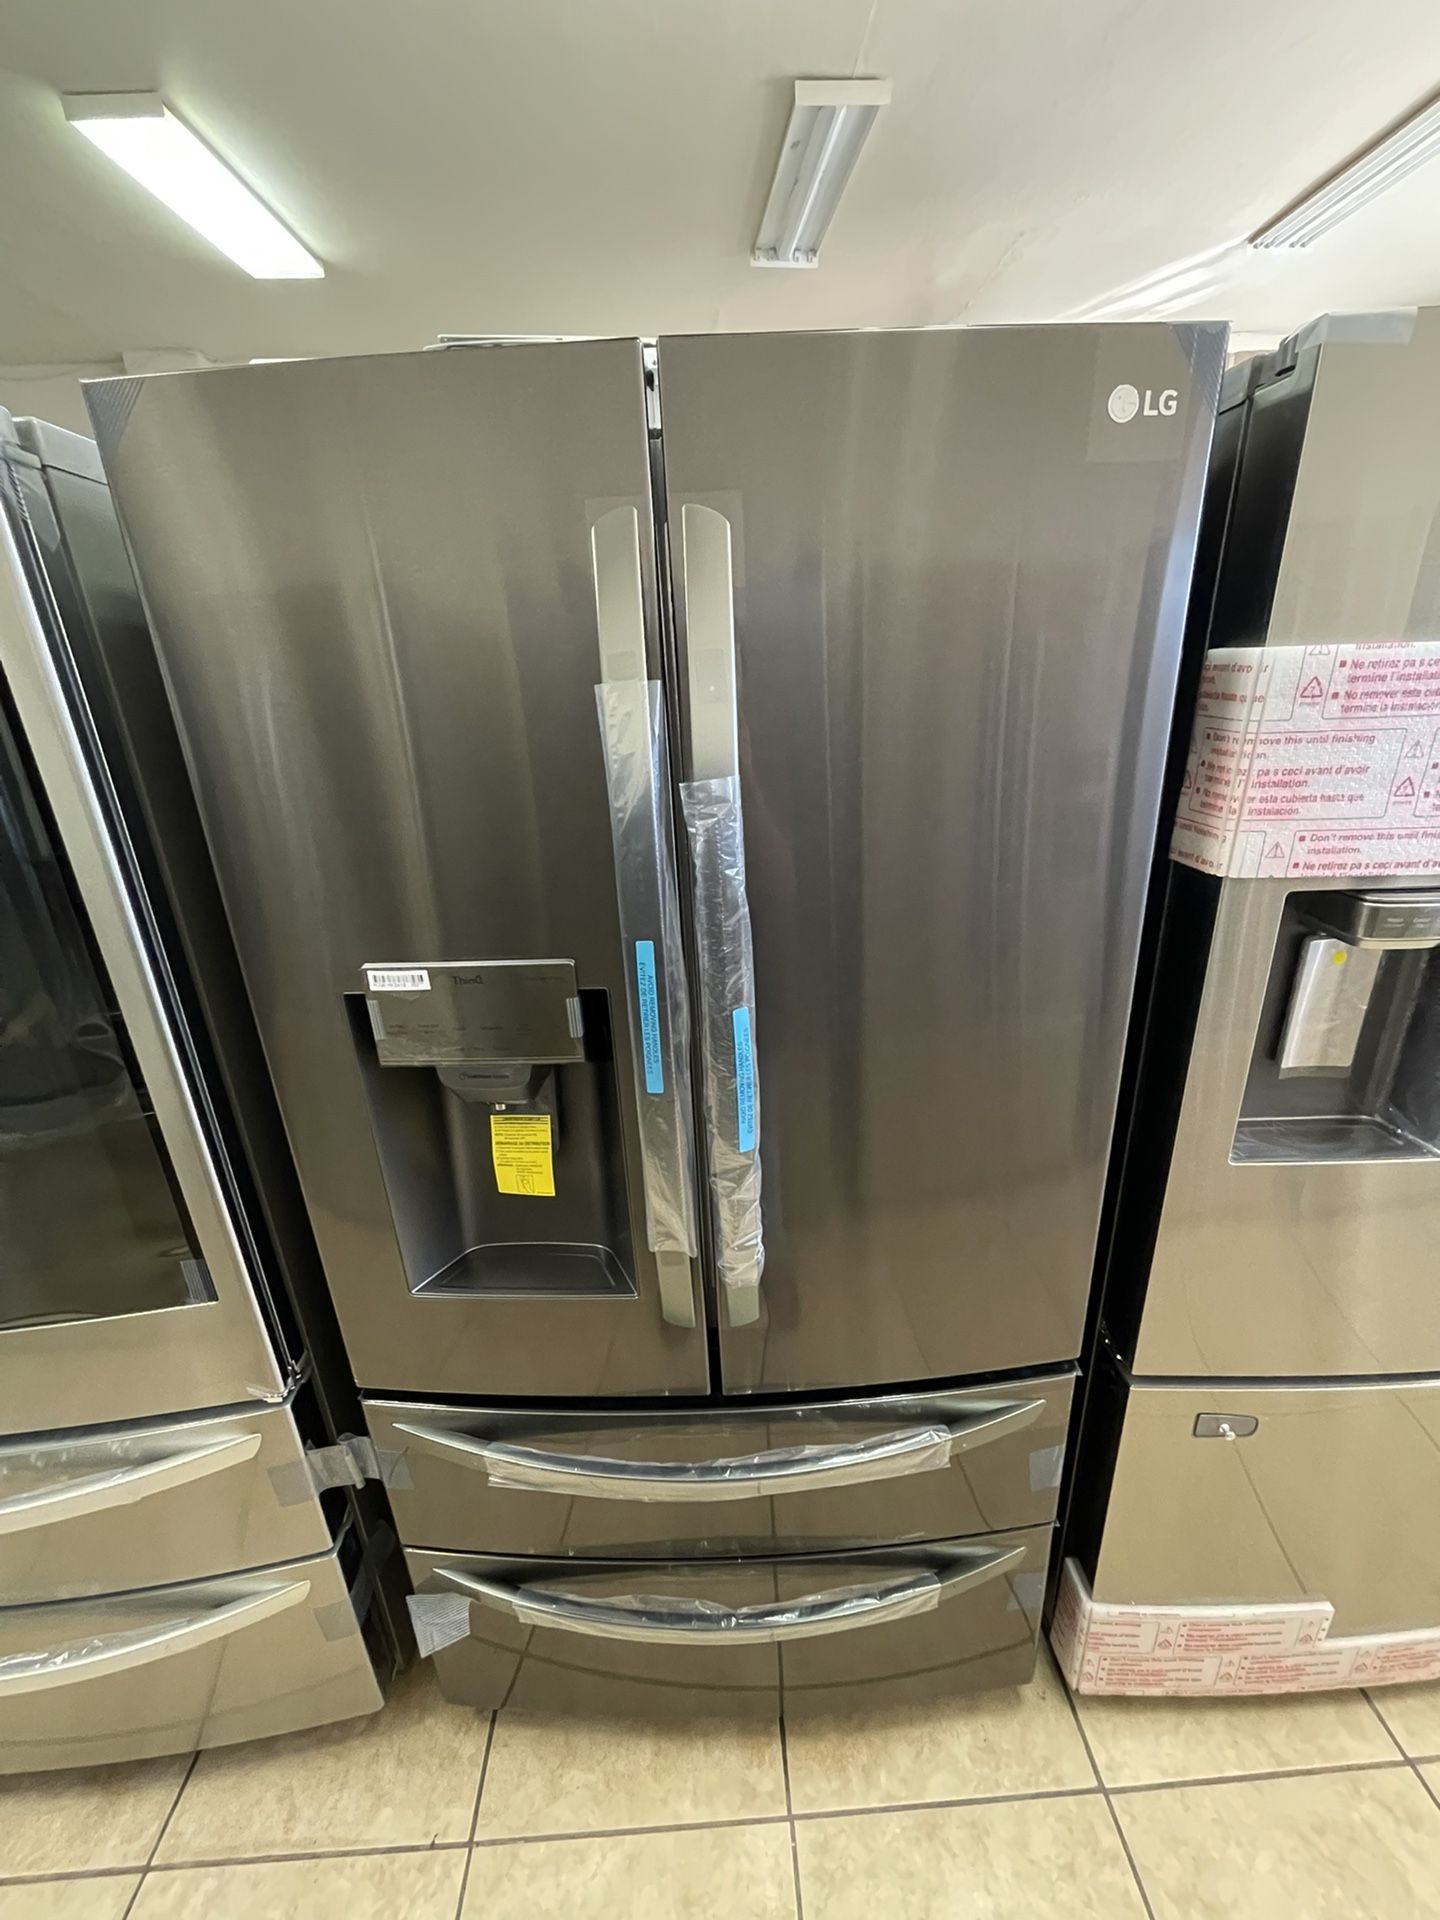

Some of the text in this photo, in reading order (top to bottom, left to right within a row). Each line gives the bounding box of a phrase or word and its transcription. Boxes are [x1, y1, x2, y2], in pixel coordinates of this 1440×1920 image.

[1143, 389, 1178, 416] LG
[1349, 659, 1366, 670] Ne
[1283, 734, 1303, 745] this
[1304, 766, 1333, 776] avant
[1338, 832, 1375, 842] remove
[1376, 831, 1395, 841] this
[647, 974, 656, 996] AVOID
[641, 986, 648, 998] DE
[648, 996, 658, 1032] REMOVING
